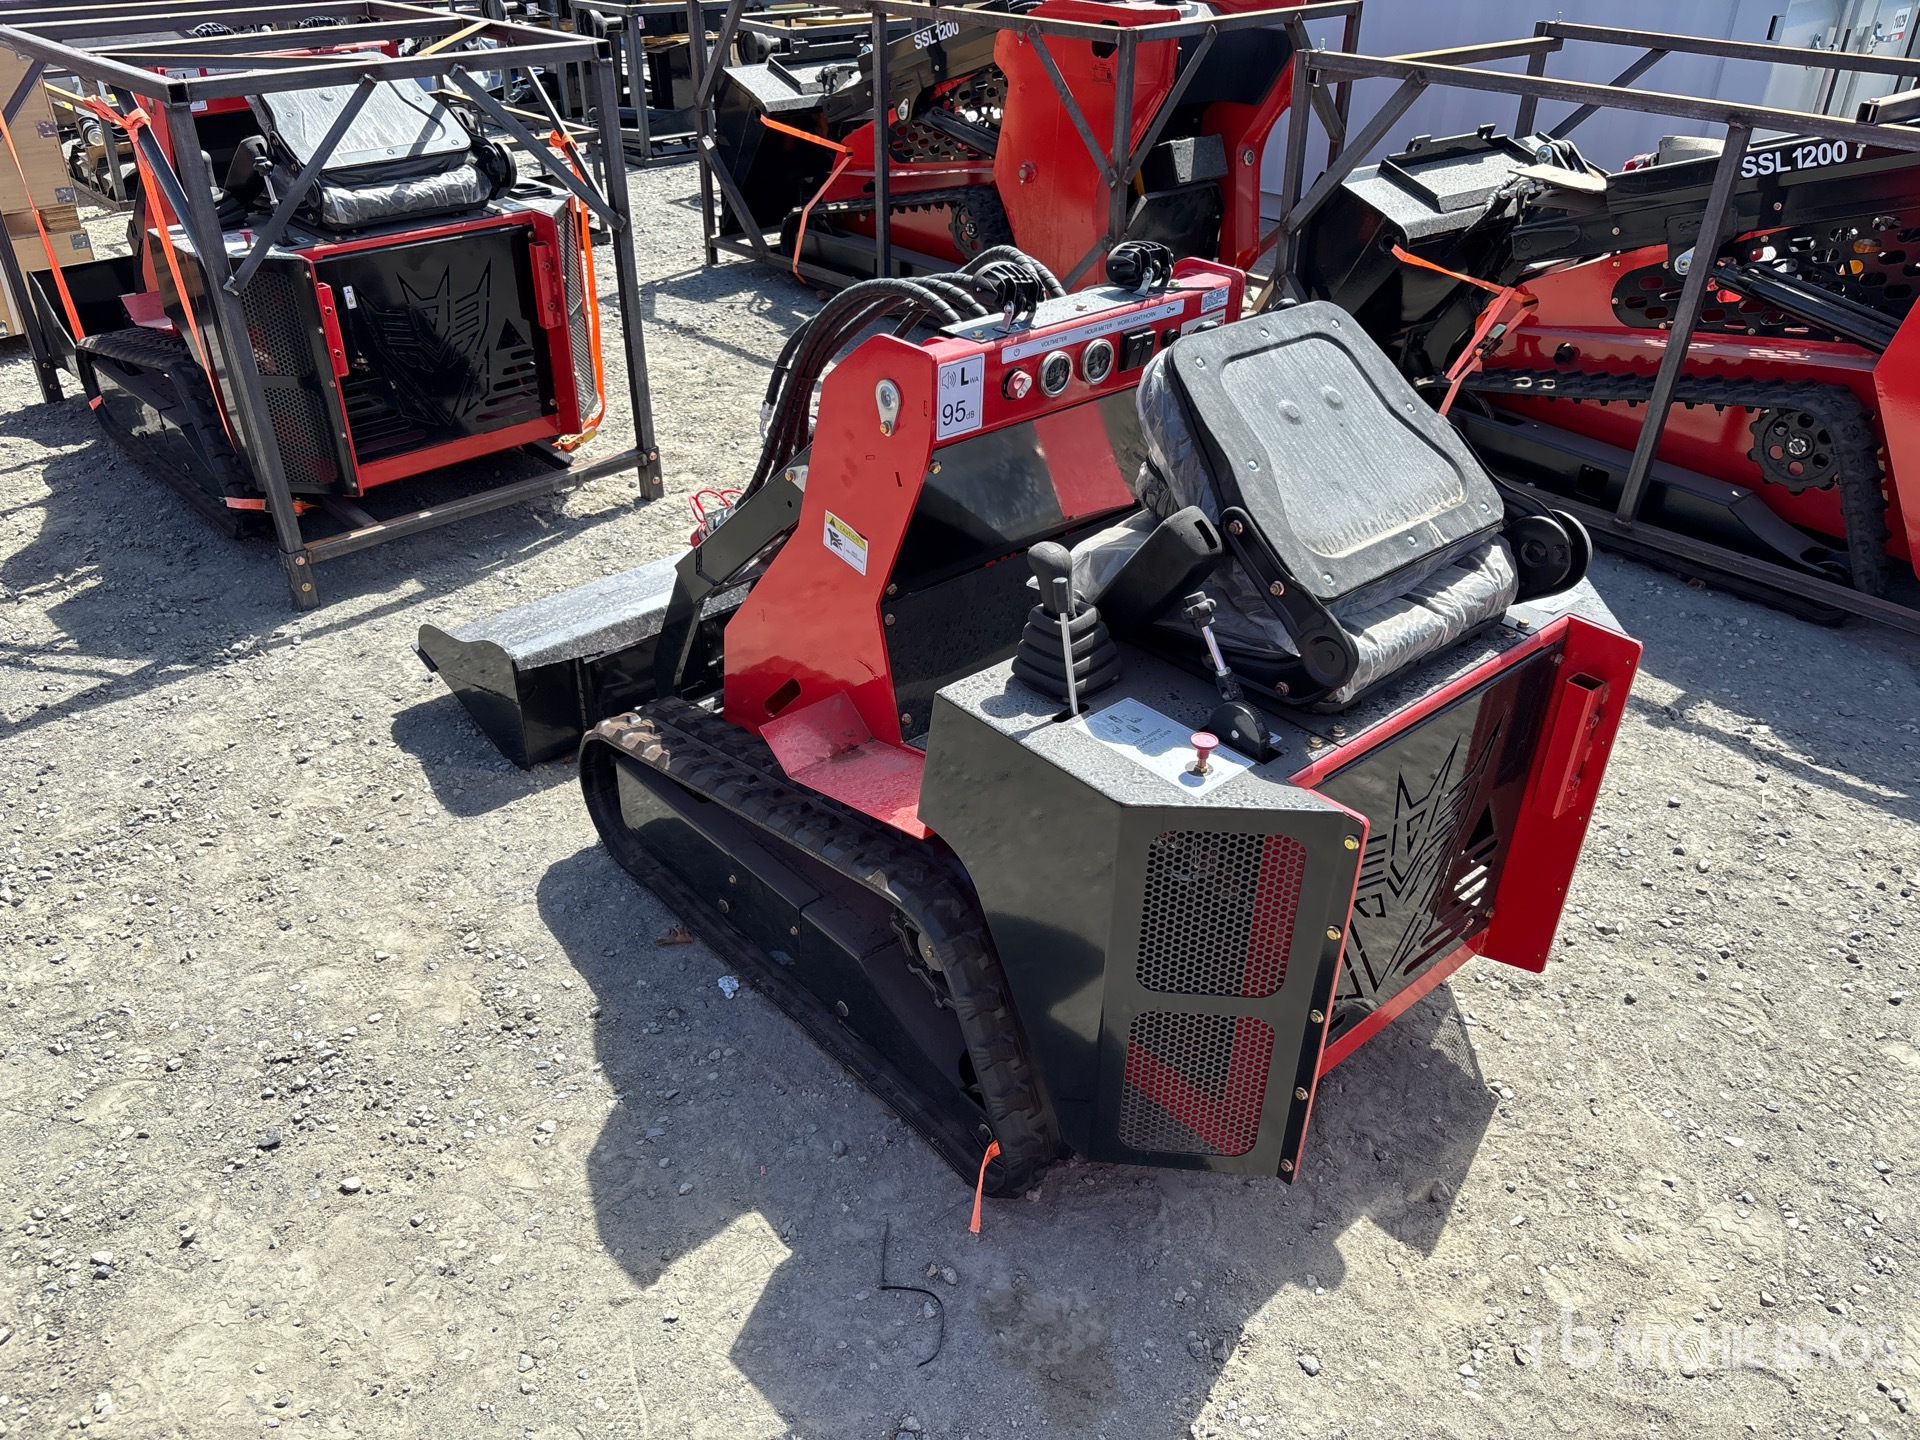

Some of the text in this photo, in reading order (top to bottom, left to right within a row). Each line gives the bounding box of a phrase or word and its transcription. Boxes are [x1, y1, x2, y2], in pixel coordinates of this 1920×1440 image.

[914, 22, 960, 50] SSL 1200
[1740, 140, 1848, 178] SSL 1200
[1084, 323, 1113, 336] HOUR METER
[1040, 336, 1068, 348] VOLTMETER
